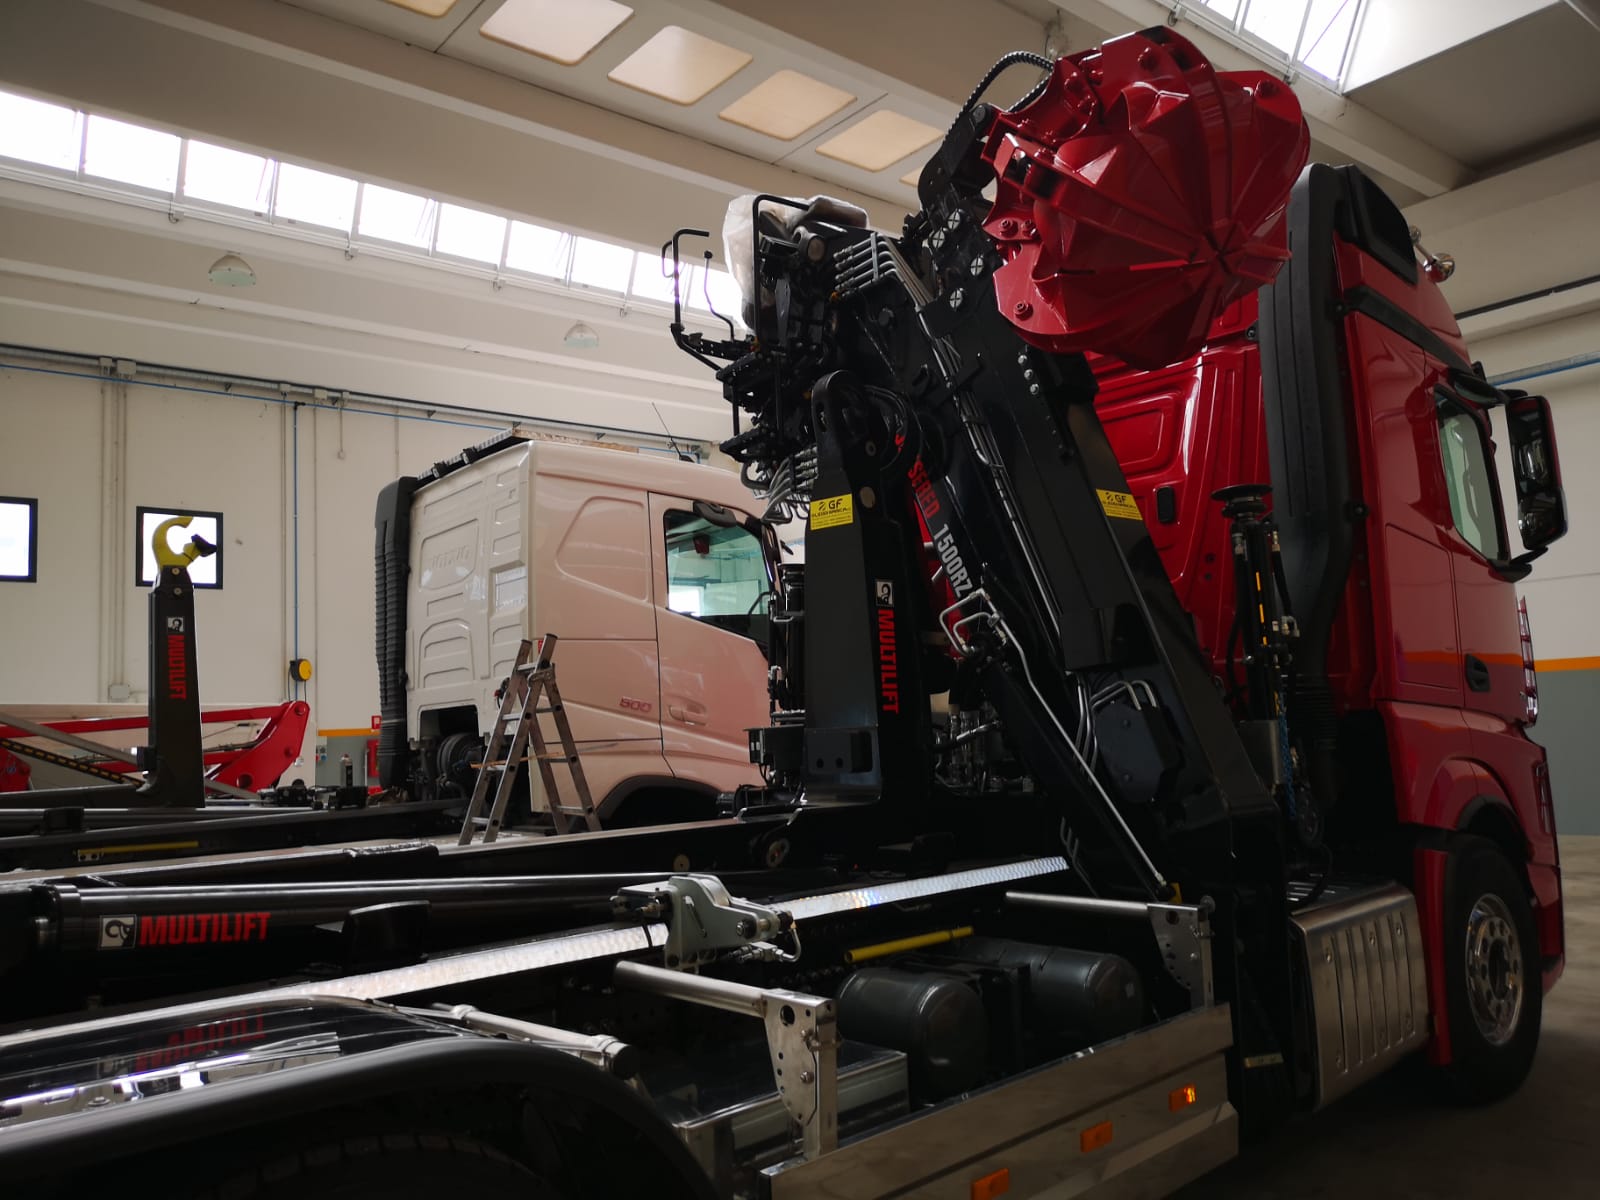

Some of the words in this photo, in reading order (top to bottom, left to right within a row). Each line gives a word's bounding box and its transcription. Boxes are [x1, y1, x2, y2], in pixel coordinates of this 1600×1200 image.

[829, 497, 844, 510] GF
[932, 523, 974, 598] 1500RZ
[167, 634, 188, 700] MULTILIFT
[878, 608, 900, 714] MULTILIFT
[619, 696, 653, 713] 500
[140, 913, 271, 946] MULTILIFT
